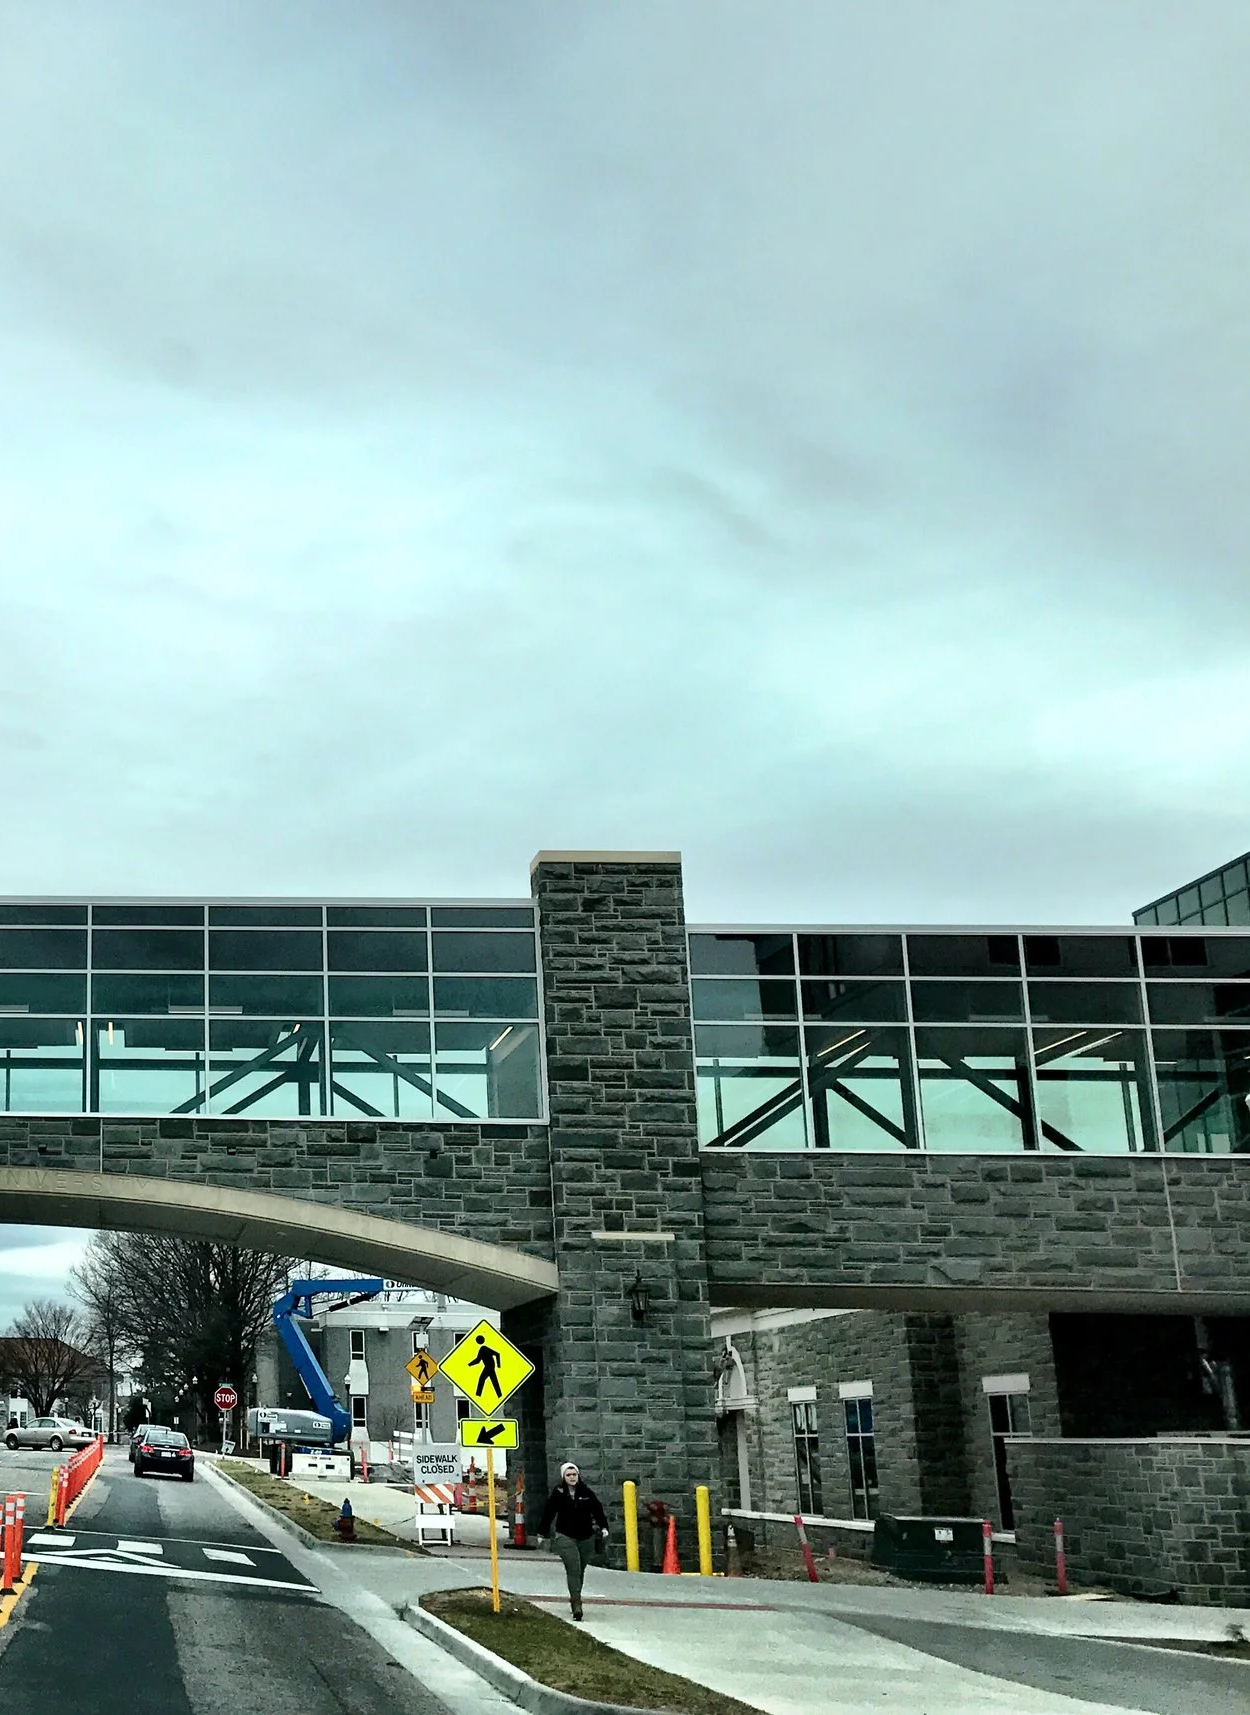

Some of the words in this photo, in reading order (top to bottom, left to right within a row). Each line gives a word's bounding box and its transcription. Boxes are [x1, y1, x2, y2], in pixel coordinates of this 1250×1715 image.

[216, 1393, 236, 1403] STOP
[416, 1454, 458, 1464] SIDEWALK
[420, 1464, 455, 1474] CLOSED
